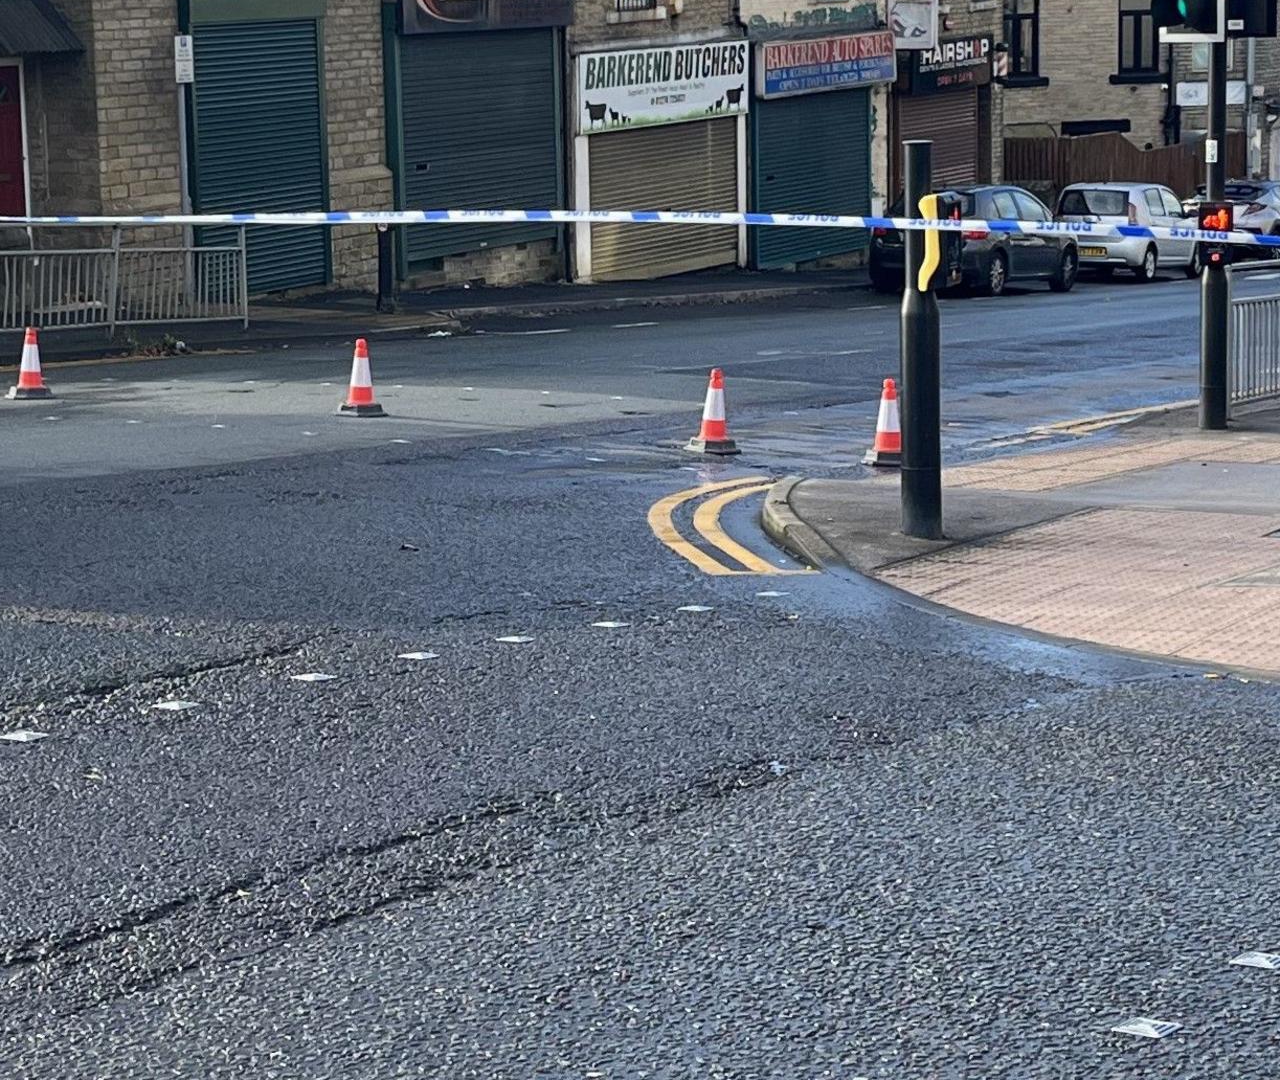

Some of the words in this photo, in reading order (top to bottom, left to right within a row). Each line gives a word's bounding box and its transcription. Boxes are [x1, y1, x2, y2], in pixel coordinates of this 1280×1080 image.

[585, 50, 672, 90] BARKEREND
[674, 43, 746, 81] BUTCHERS
[766, 41, 830, 69] BARKEREND
[831, 38, 858, 62] AUTO
[860, 33, 893, 58] SPARES
